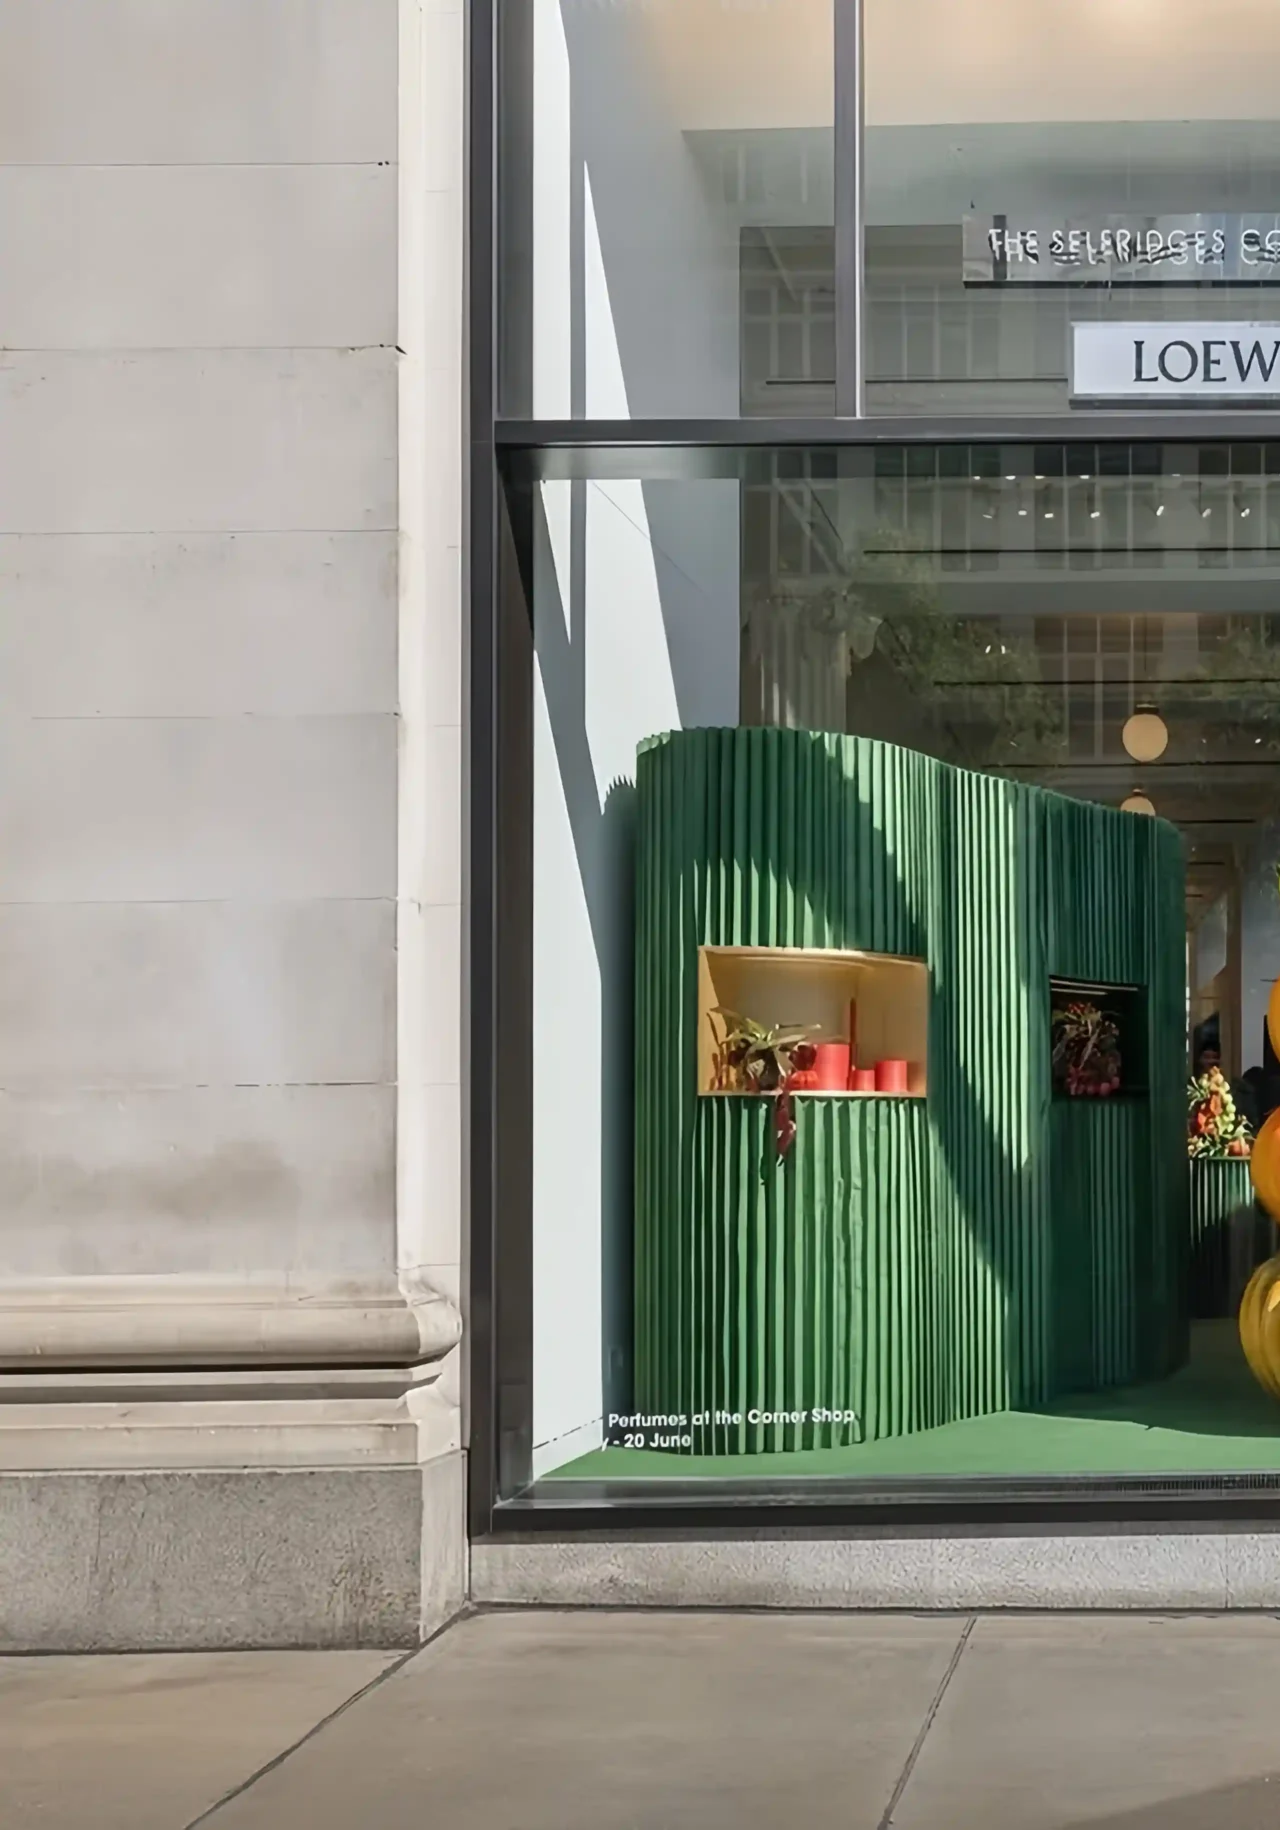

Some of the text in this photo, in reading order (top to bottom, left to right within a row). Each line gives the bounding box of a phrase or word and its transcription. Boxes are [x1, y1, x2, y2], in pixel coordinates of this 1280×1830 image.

[988, 229, 1038, 257] THE
[1051, 229, 1225, 257] SELFRIDGES
[608, 1407, 856, 1428] Perfumes at the Corner Shop
[623, 1433, 645, 1449] 20
[649, 1432, 692, 1449] June
